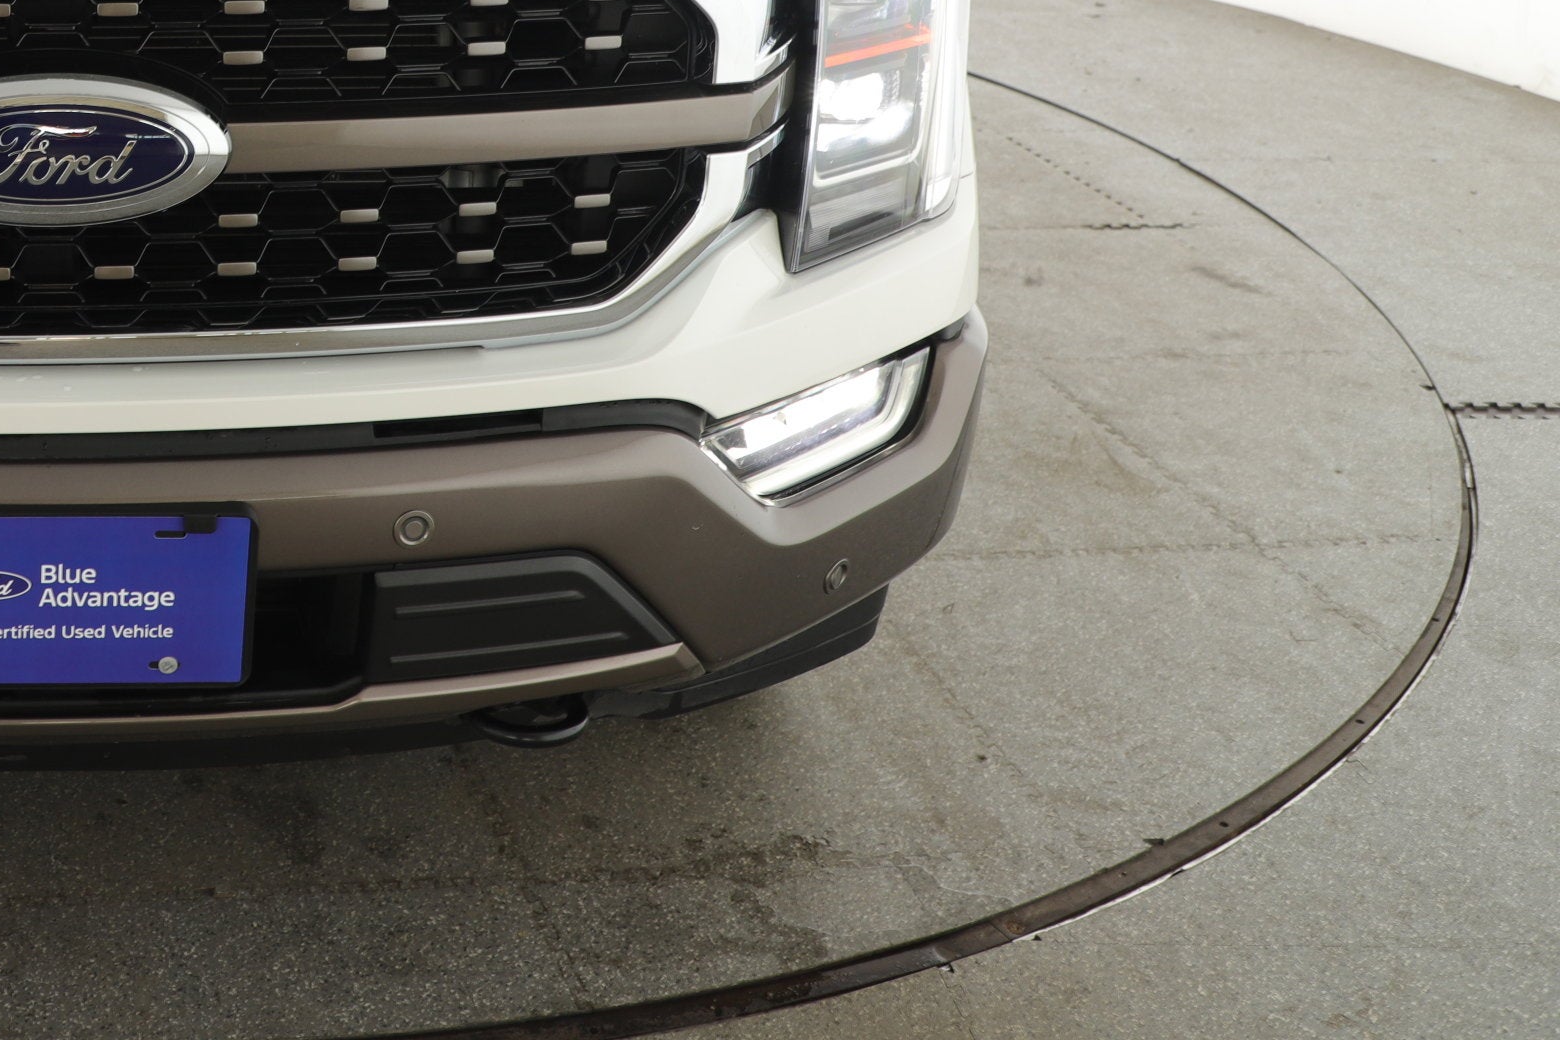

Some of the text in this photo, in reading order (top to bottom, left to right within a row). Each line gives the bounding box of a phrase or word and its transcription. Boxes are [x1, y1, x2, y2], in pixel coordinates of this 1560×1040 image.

[40, 563, 97, 584] Blue
[39, 587, 175, 610] Advantage
[61, 624, 106, 639] Used
[111, 624, 174, 639] Vehicle
